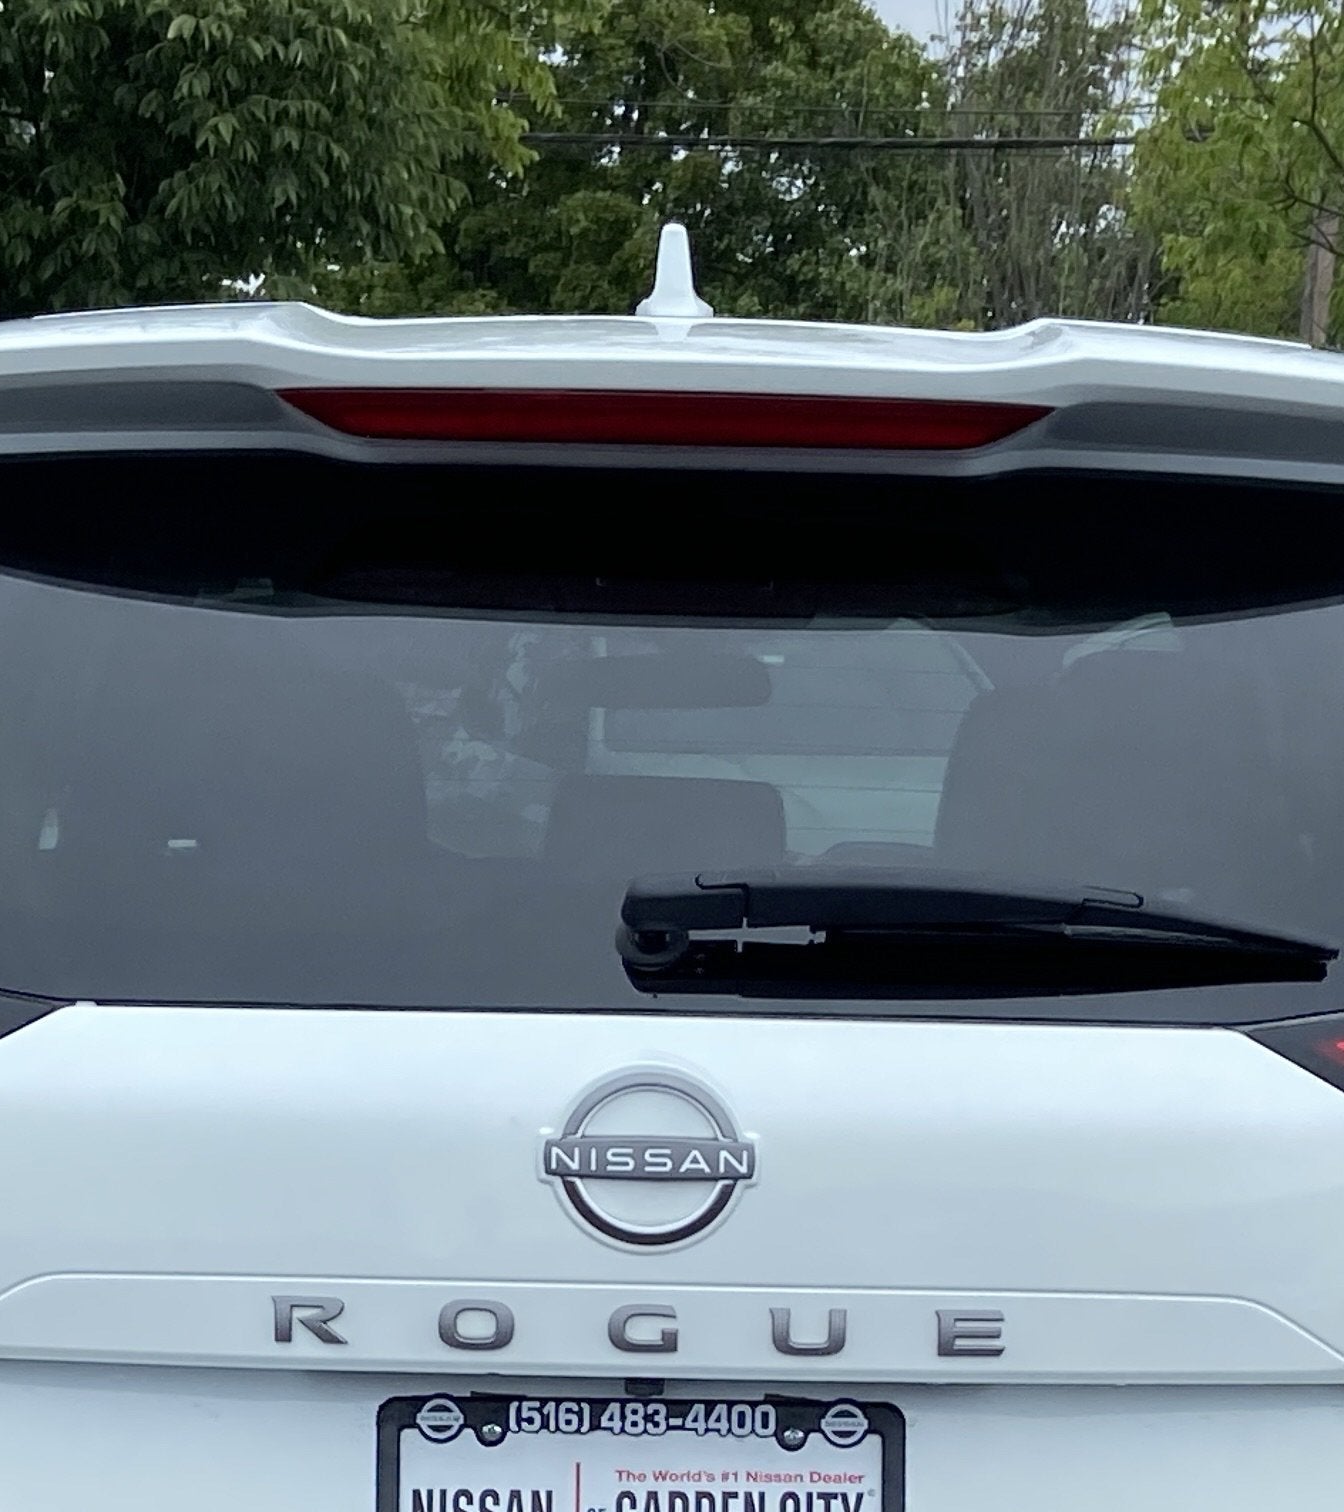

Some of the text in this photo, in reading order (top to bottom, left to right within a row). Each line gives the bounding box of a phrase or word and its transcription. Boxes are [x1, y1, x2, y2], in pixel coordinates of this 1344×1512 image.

[550, 1146, 749, 1175] NISSAN
[270, 1294, 1006, 1357] ROGUE
[509, 1400, 777, 1436] (516) 483-4400
[615, 1469, 865, 1485] The World's #1 Nissan Dealer
